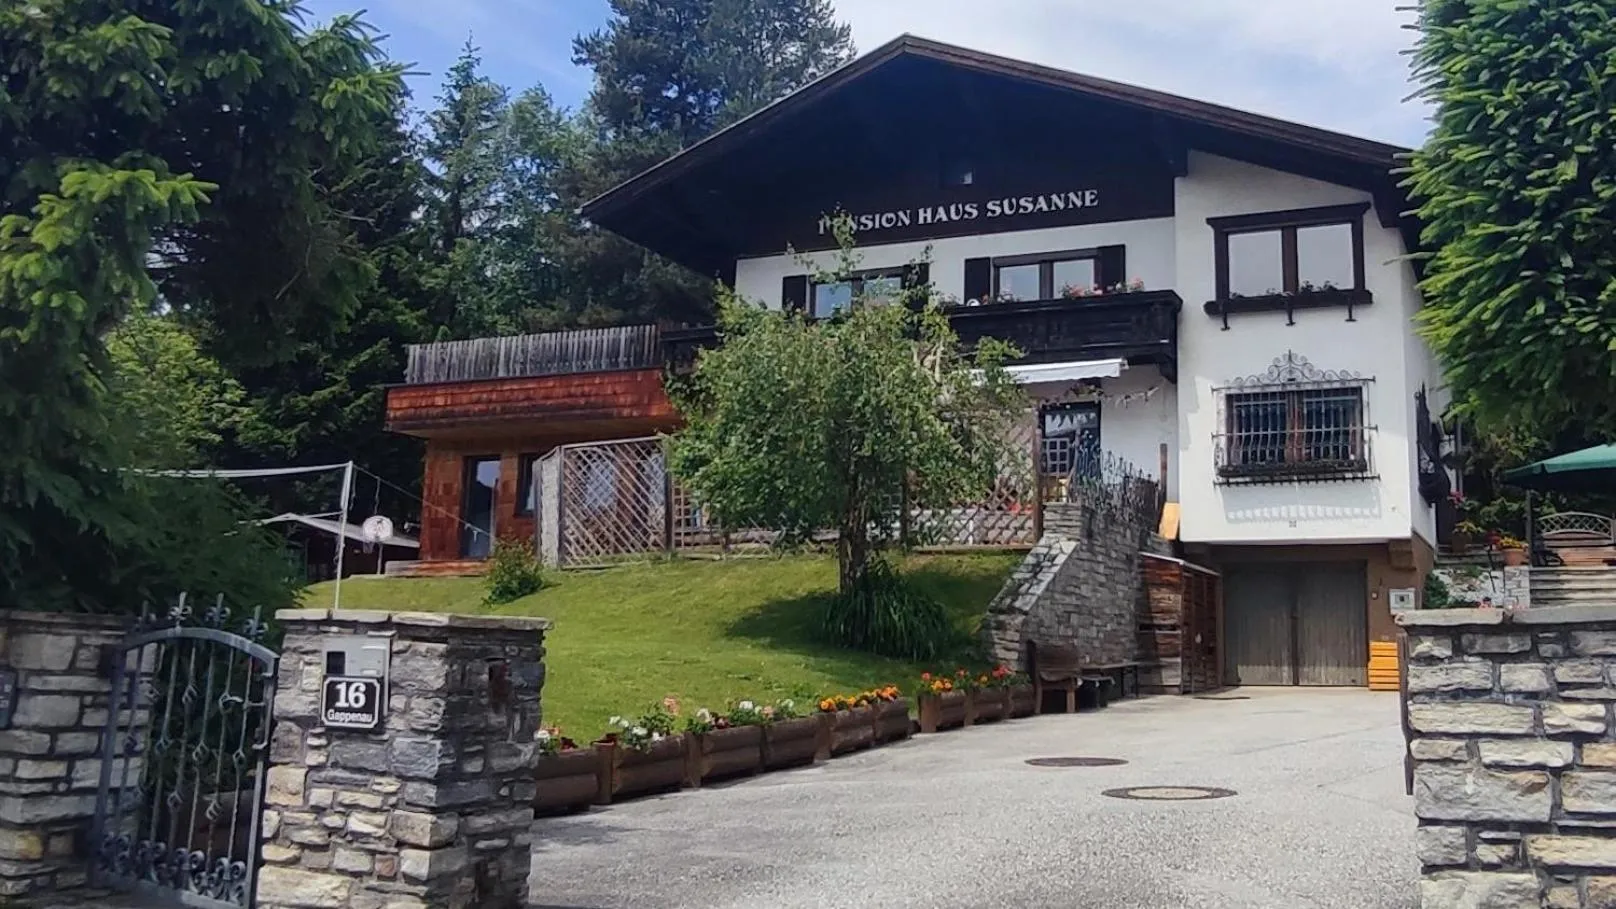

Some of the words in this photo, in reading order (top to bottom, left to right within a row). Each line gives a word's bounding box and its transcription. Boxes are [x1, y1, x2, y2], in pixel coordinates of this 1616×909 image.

[917, 203, 978, 225] HAUS
[986, 189, 1099, 217] SUSANNE
[334, 681, 367, 708] 16
[326, 708, 373, 723] Gappenau
